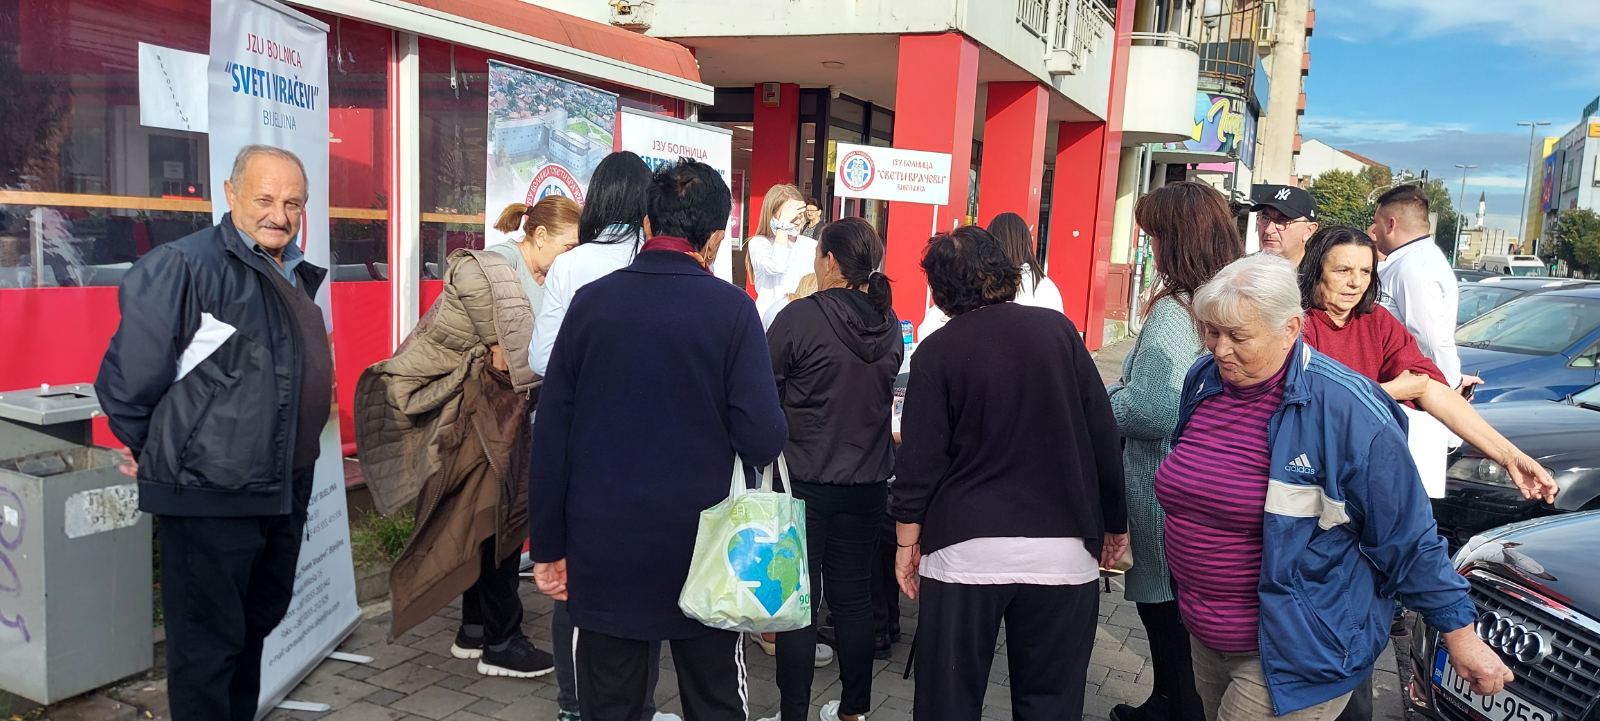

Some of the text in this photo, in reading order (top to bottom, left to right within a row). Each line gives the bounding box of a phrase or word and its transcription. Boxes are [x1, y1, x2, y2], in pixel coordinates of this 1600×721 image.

[246, 33, 302, 68] JZU BOLNICA
[263, 110, 297, 131] BIJELJINA
[652, 139, 708, 160] ЈЗУ БОЛНИЦА
[1284, 464, 1315, 475] adidas
